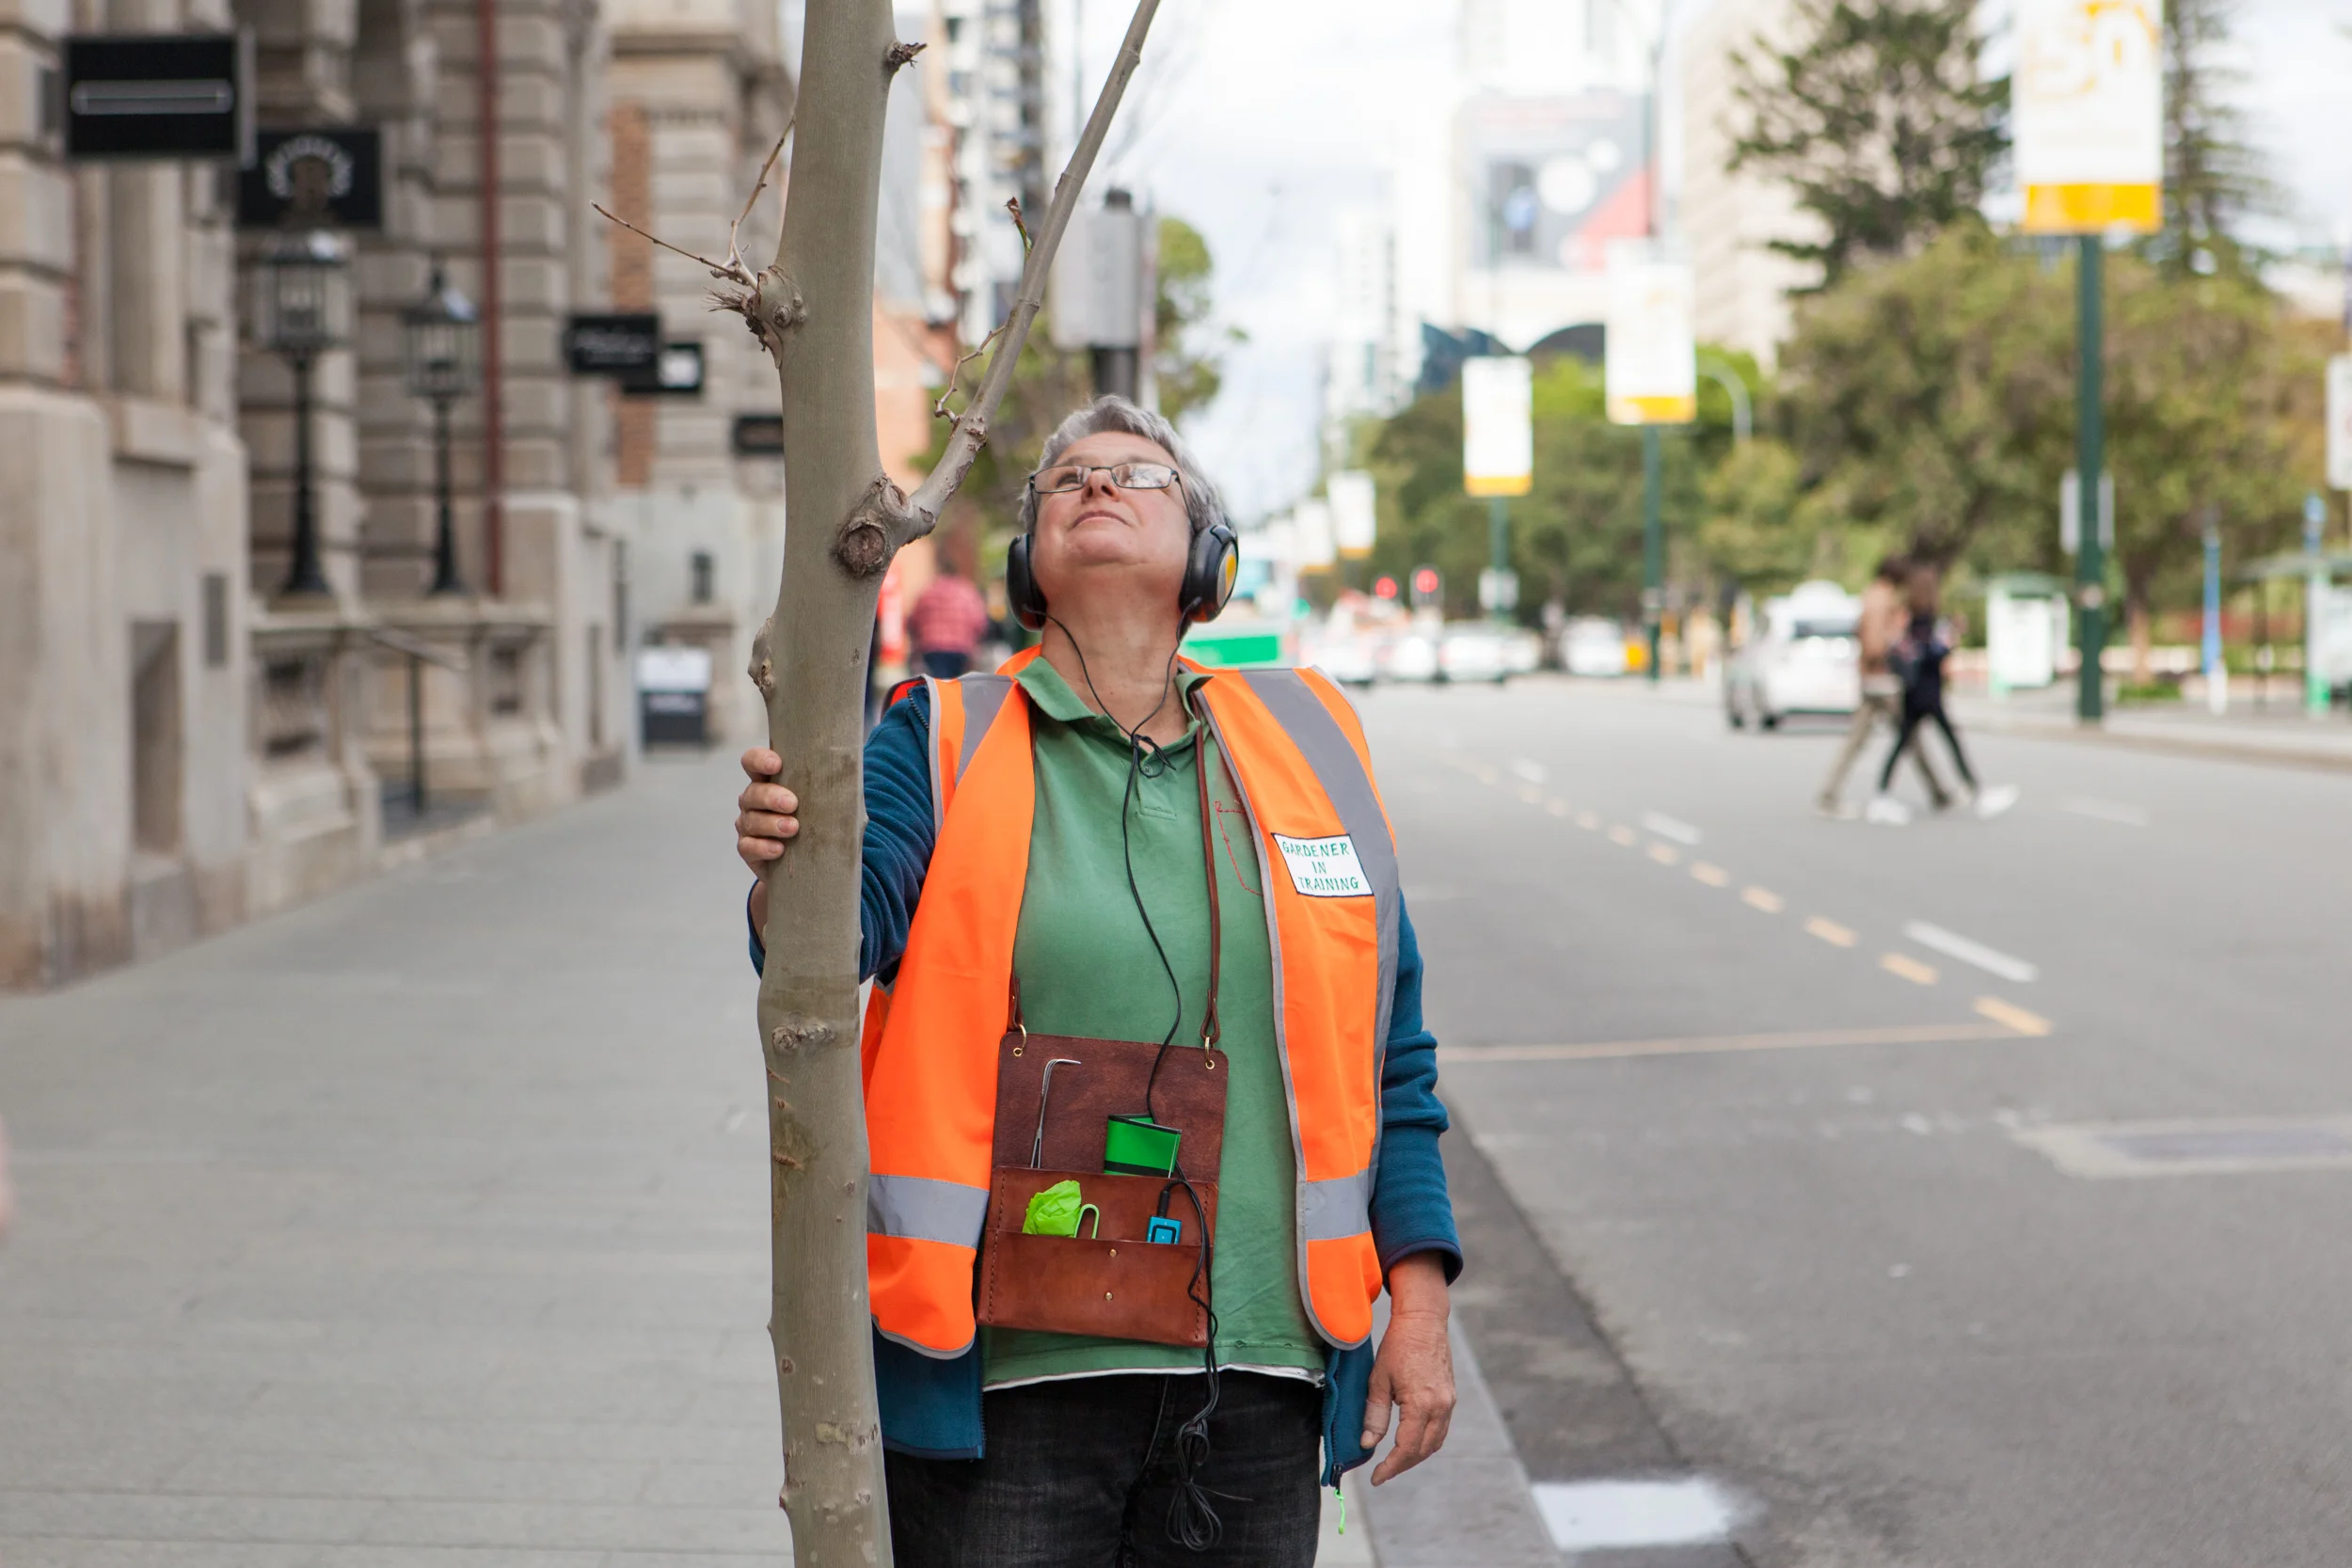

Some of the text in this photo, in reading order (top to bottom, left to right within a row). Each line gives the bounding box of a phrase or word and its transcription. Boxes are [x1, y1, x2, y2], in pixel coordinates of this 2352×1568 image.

[1282, 841, 1349, 857] GARDENER
[1311, 862, 1327, 874] IN
[1298, 877, 1359, 891] TRAINING
